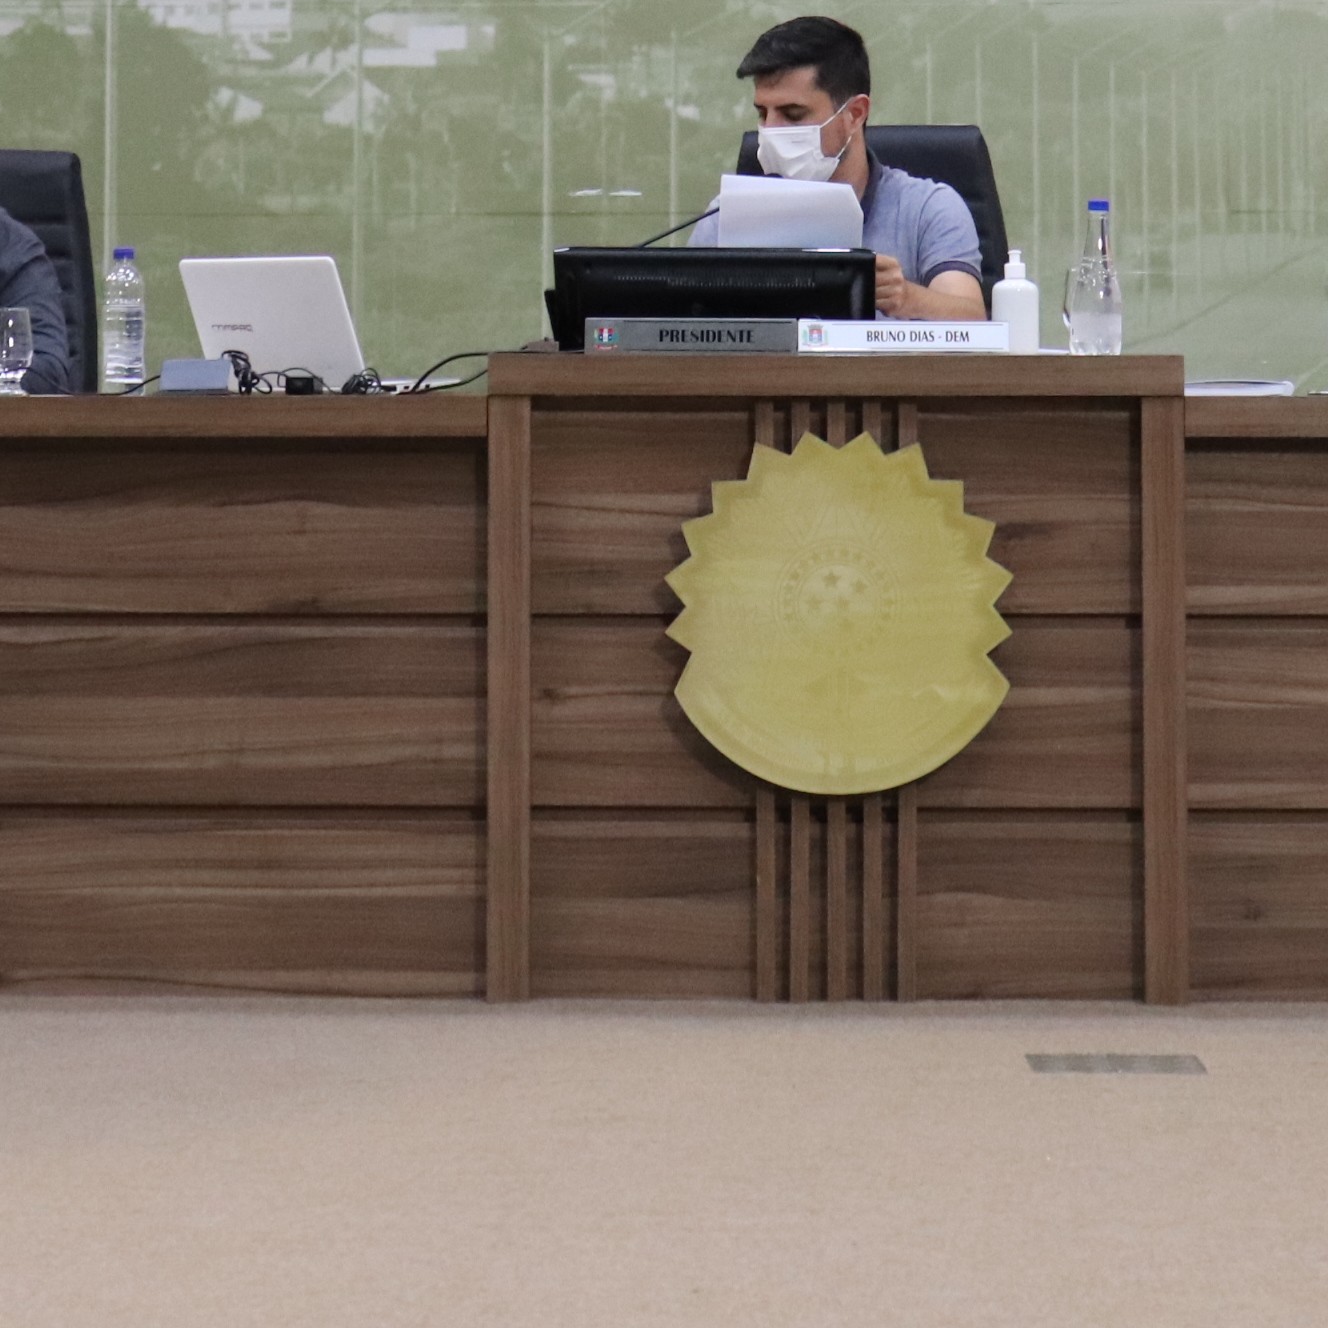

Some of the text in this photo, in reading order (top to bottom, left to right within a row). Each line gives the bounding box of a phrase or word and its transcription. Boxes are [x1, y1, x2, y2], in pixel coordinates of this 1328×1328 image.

[658, 329, 756, 344] PRESIDENTE
[866, 330, 906, 343] BRUNO
[910, 330, 935, 343] DIAS
[945, 330, 970, 343] DEM
